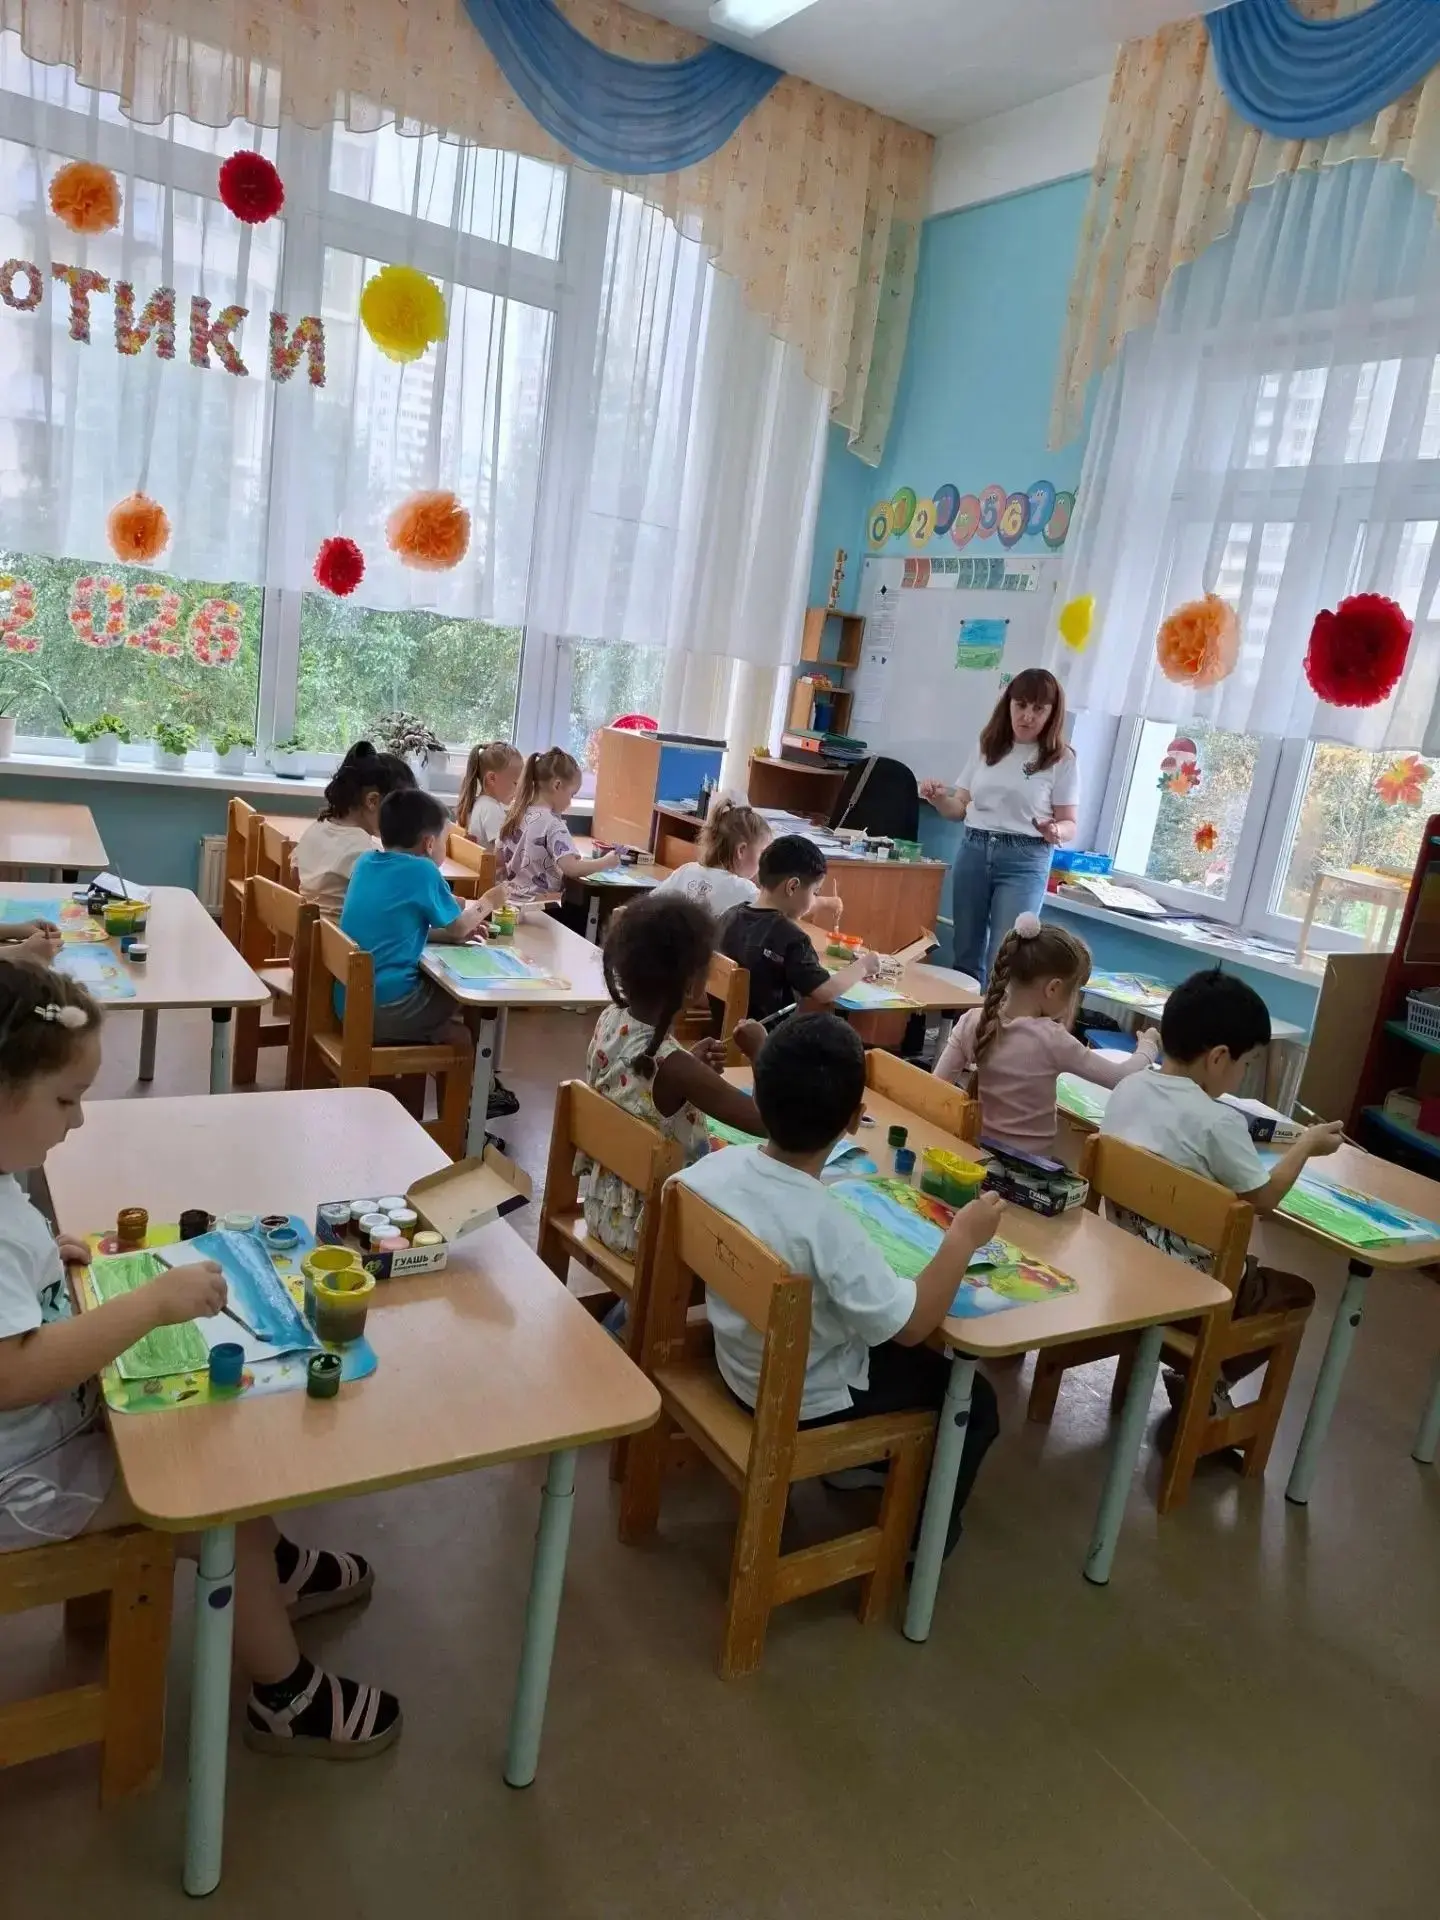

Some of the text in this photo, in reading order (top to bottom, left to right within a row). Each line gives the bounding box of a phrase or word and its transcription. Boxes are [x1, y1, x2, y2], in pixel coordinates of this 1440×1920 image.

[915, 510, 928, 539] 2
[982, 495, 998, 529] 5
[1002, 500, 1022, 536] 6
[0, 575, 244, 667] 2026
[394, 1254, 429, 1267] ГУАШЬ
